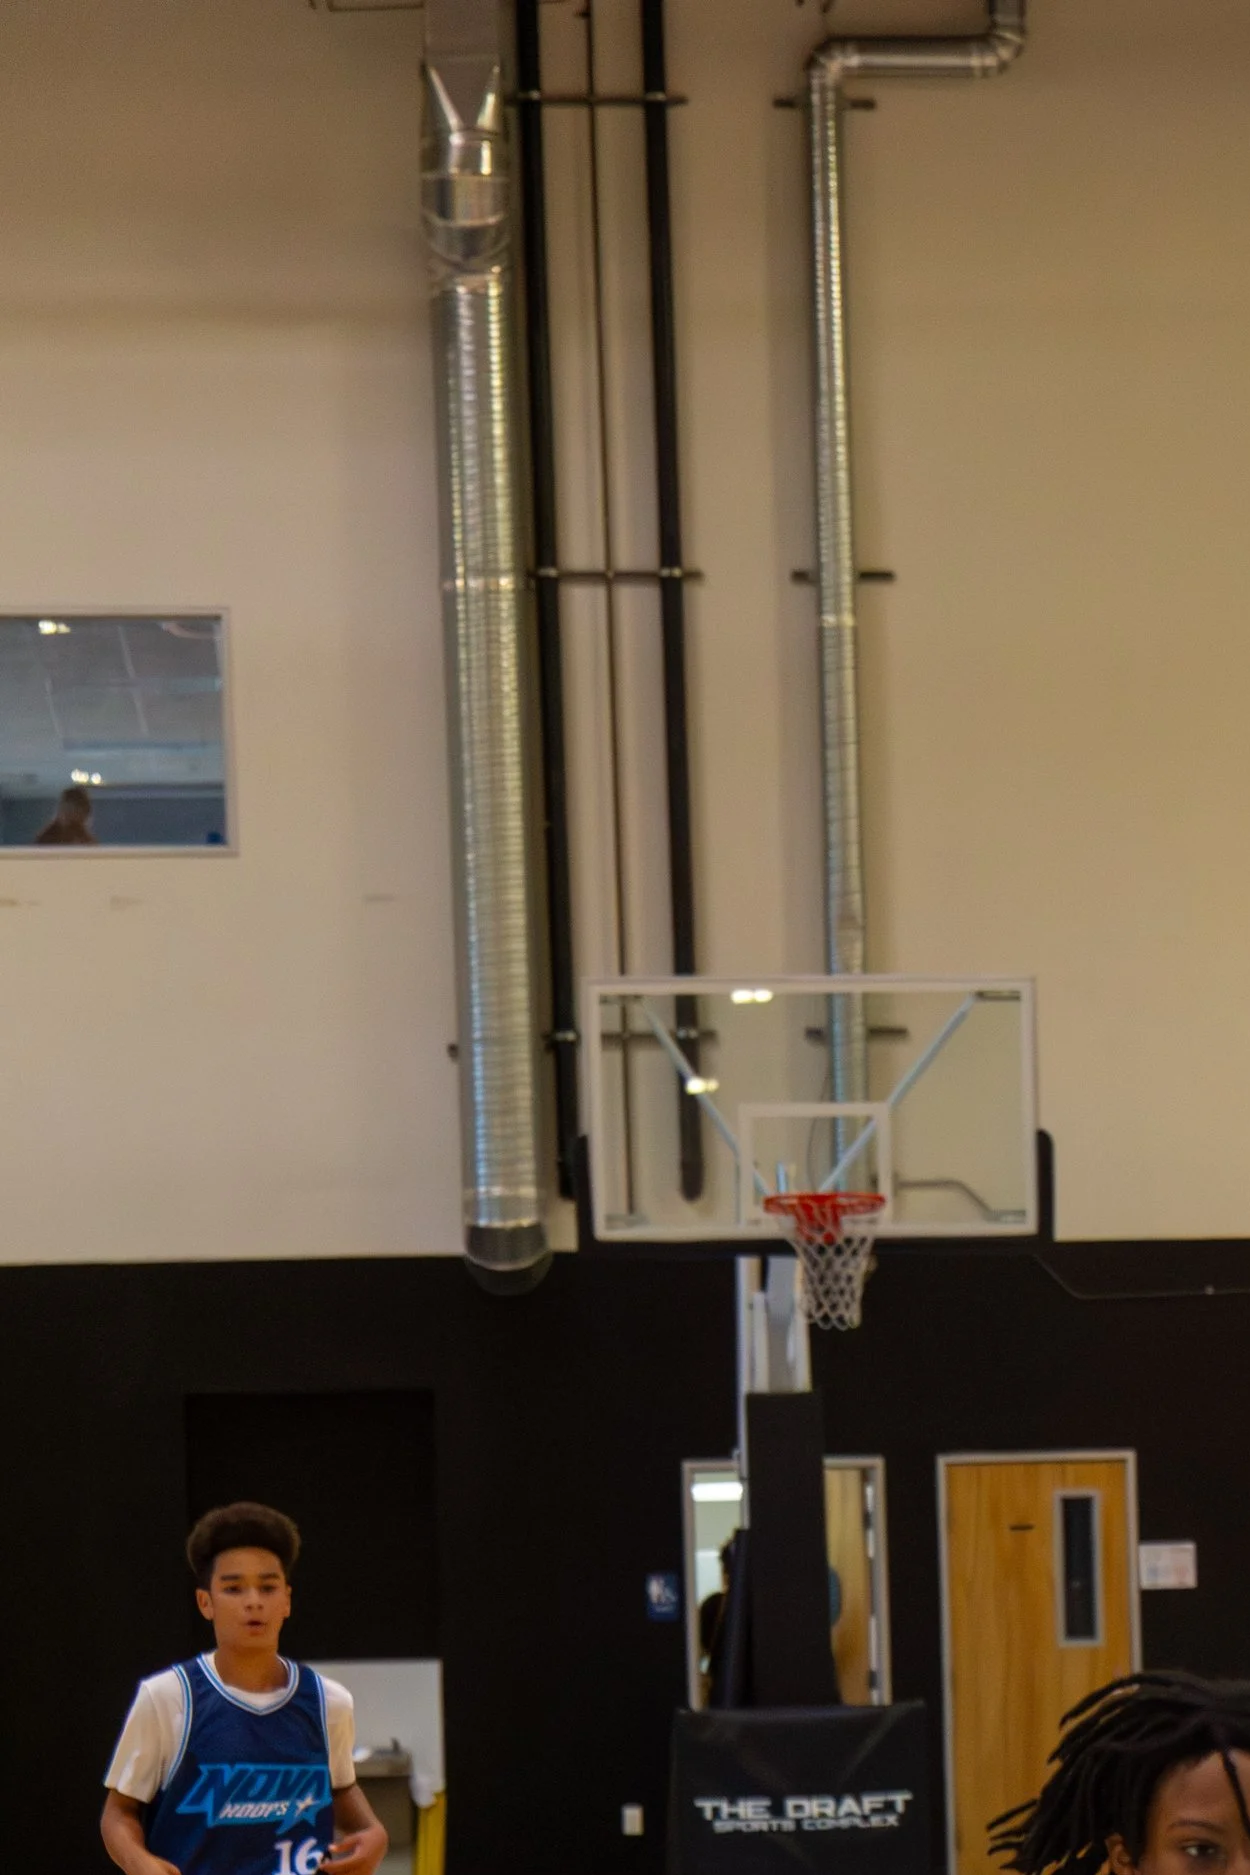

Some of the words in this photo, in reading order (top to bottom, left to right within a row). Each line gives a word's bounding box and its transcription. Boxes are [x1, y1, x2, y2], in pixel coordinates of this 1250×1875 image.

[219, 1800, 290, 1819] HOOPS
[694, 1797, 772, 1820] THE
[784, 1790, 912, 1819] DRAFT
[713, 1818, 796, 1833] SPORTS
[802, 1815, 898, 1830] COMPLEX
